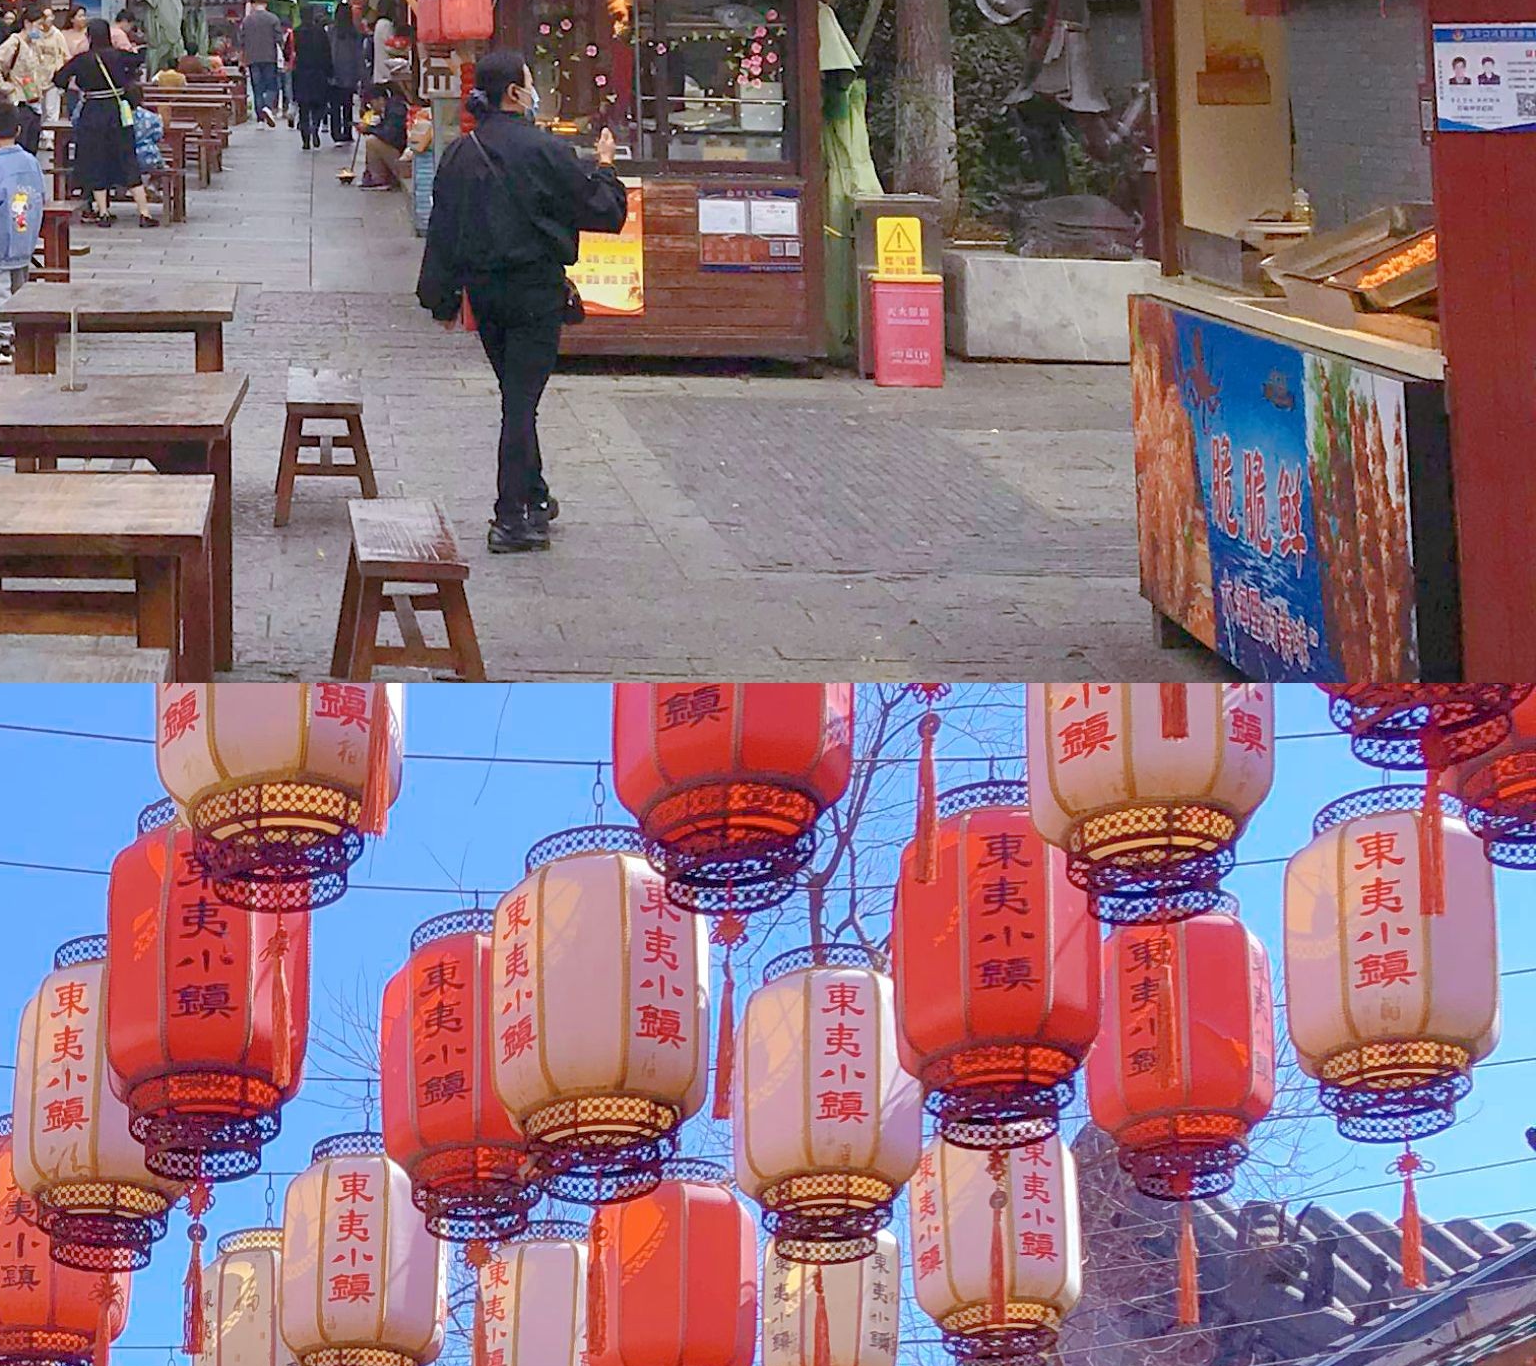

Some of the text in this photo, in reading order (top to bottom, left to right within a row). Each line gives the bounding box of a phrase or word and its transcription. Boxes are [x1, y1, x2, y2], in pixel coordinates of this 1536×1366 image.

[1212, 432, 1307, 578] 脆脆鲜
[500, 893, 538, 1065] 東夷小鎮
[636, 876, 688, 1051] 東夷小鎮
[974, 832, 1041, 993] 東夷小鎮
[1353, 830, 1418, 990] 東夷小鎮
[42, 981, 90, 1134] 東夷小鎮
[419, 960, 470, 1109] 東夷小鎮
[815, 982, 870, 1123] 東夷小鎮
[328, 1168, 375, 1304] 東夷小鎮
[916, 1150, 945, 1282] 東夷小鎮
[1018, 1141, 1061, 1263] 東夷小鎮
[869, 1252, 892, 1352] 東夷小鎮
